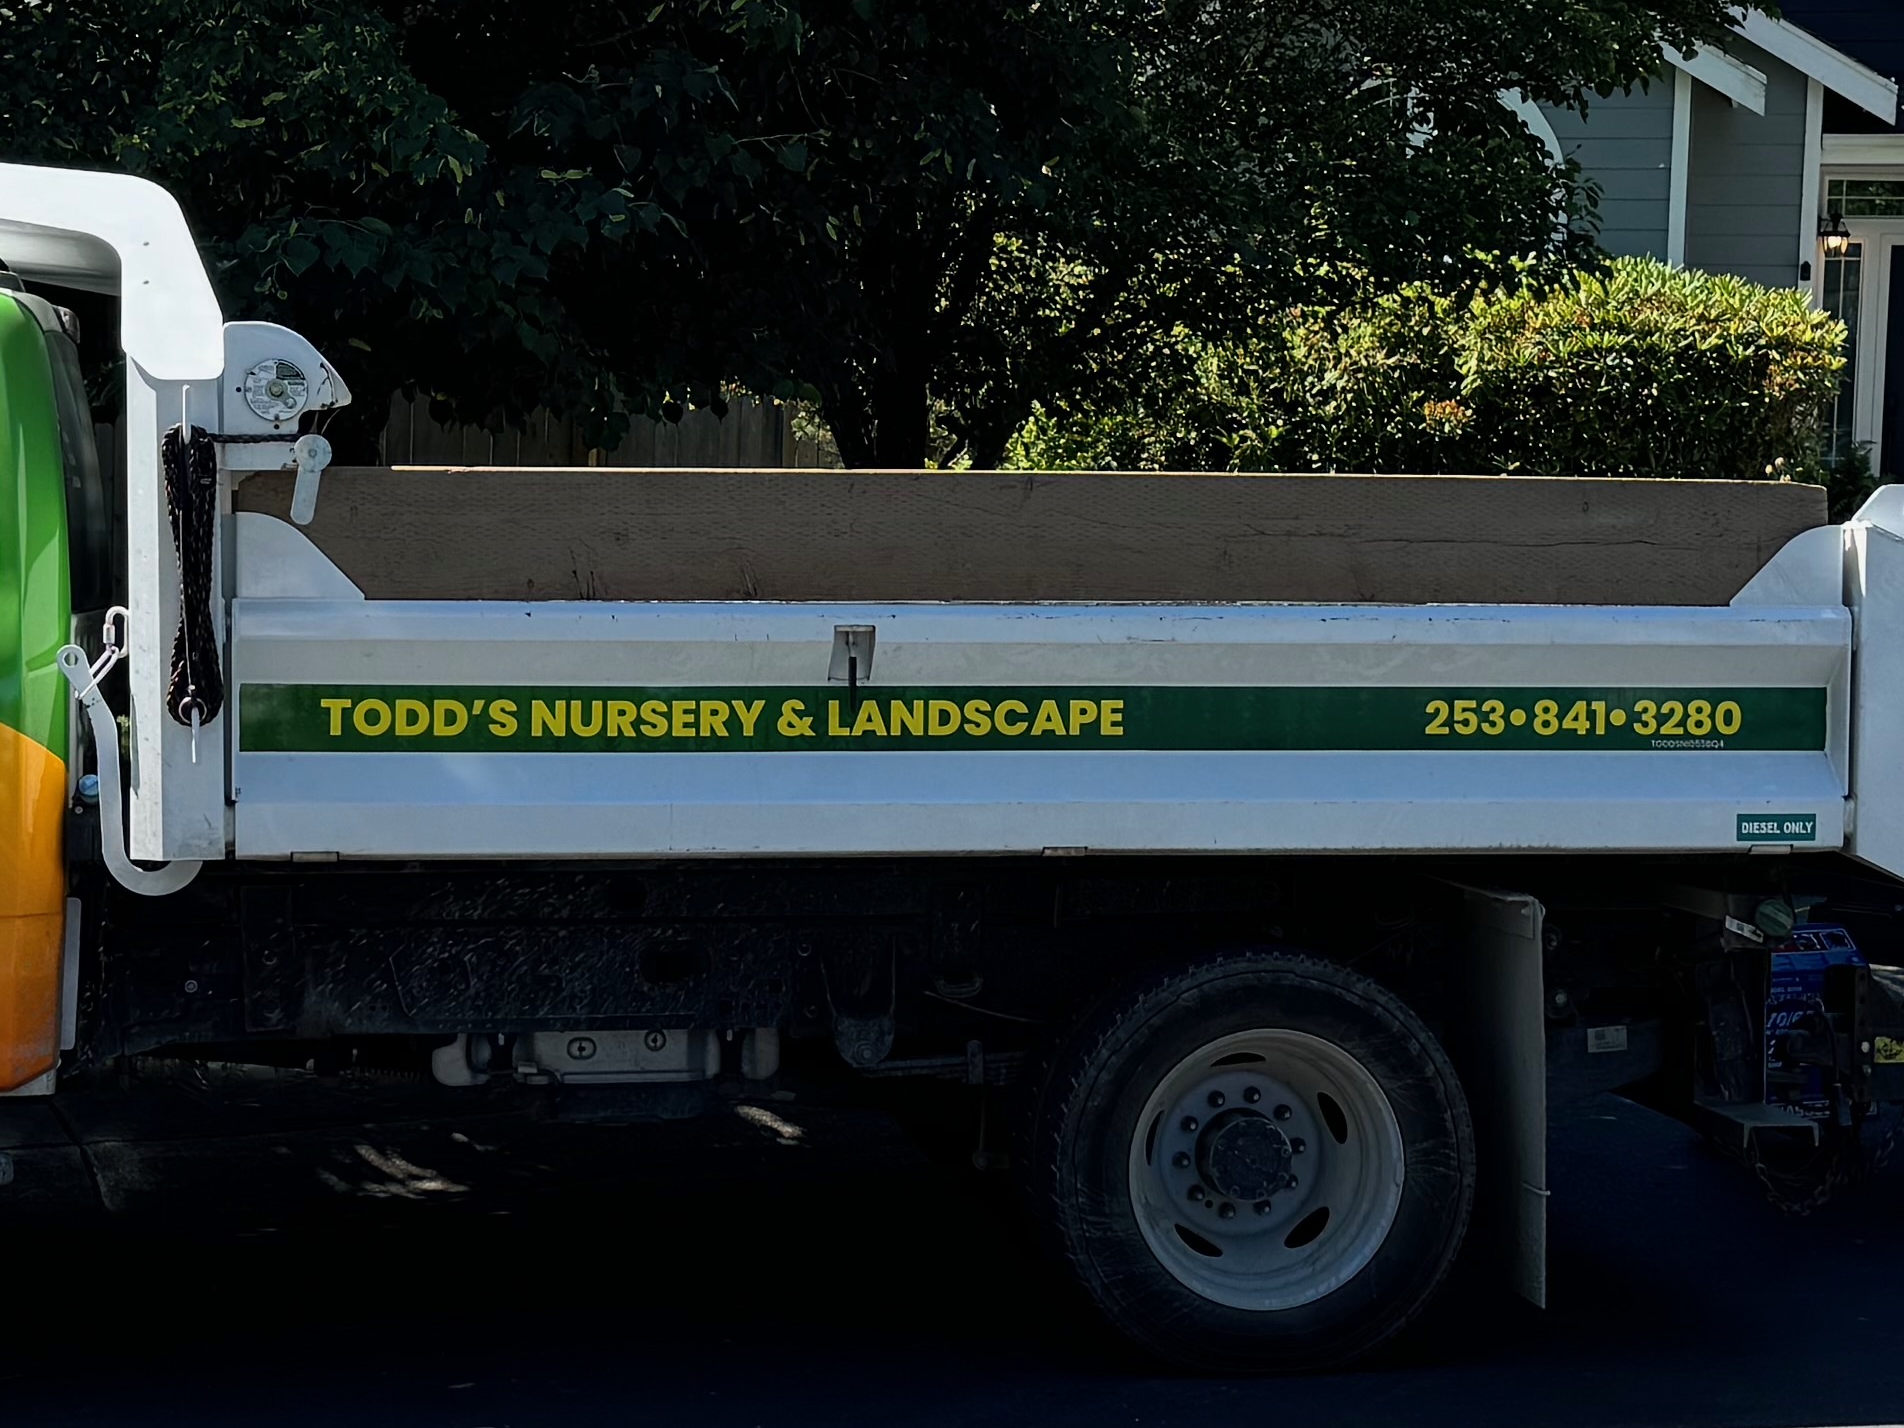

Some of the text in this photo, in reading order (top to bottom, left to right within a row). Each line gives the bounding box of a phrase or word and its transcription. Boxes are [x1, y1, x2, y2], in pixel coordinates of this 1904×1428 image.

[320, 698, 1124, 737] TODD'S NURSERY & LANDSCAPE
[1741, 820, 1814, 834] DIESEL ONLY
